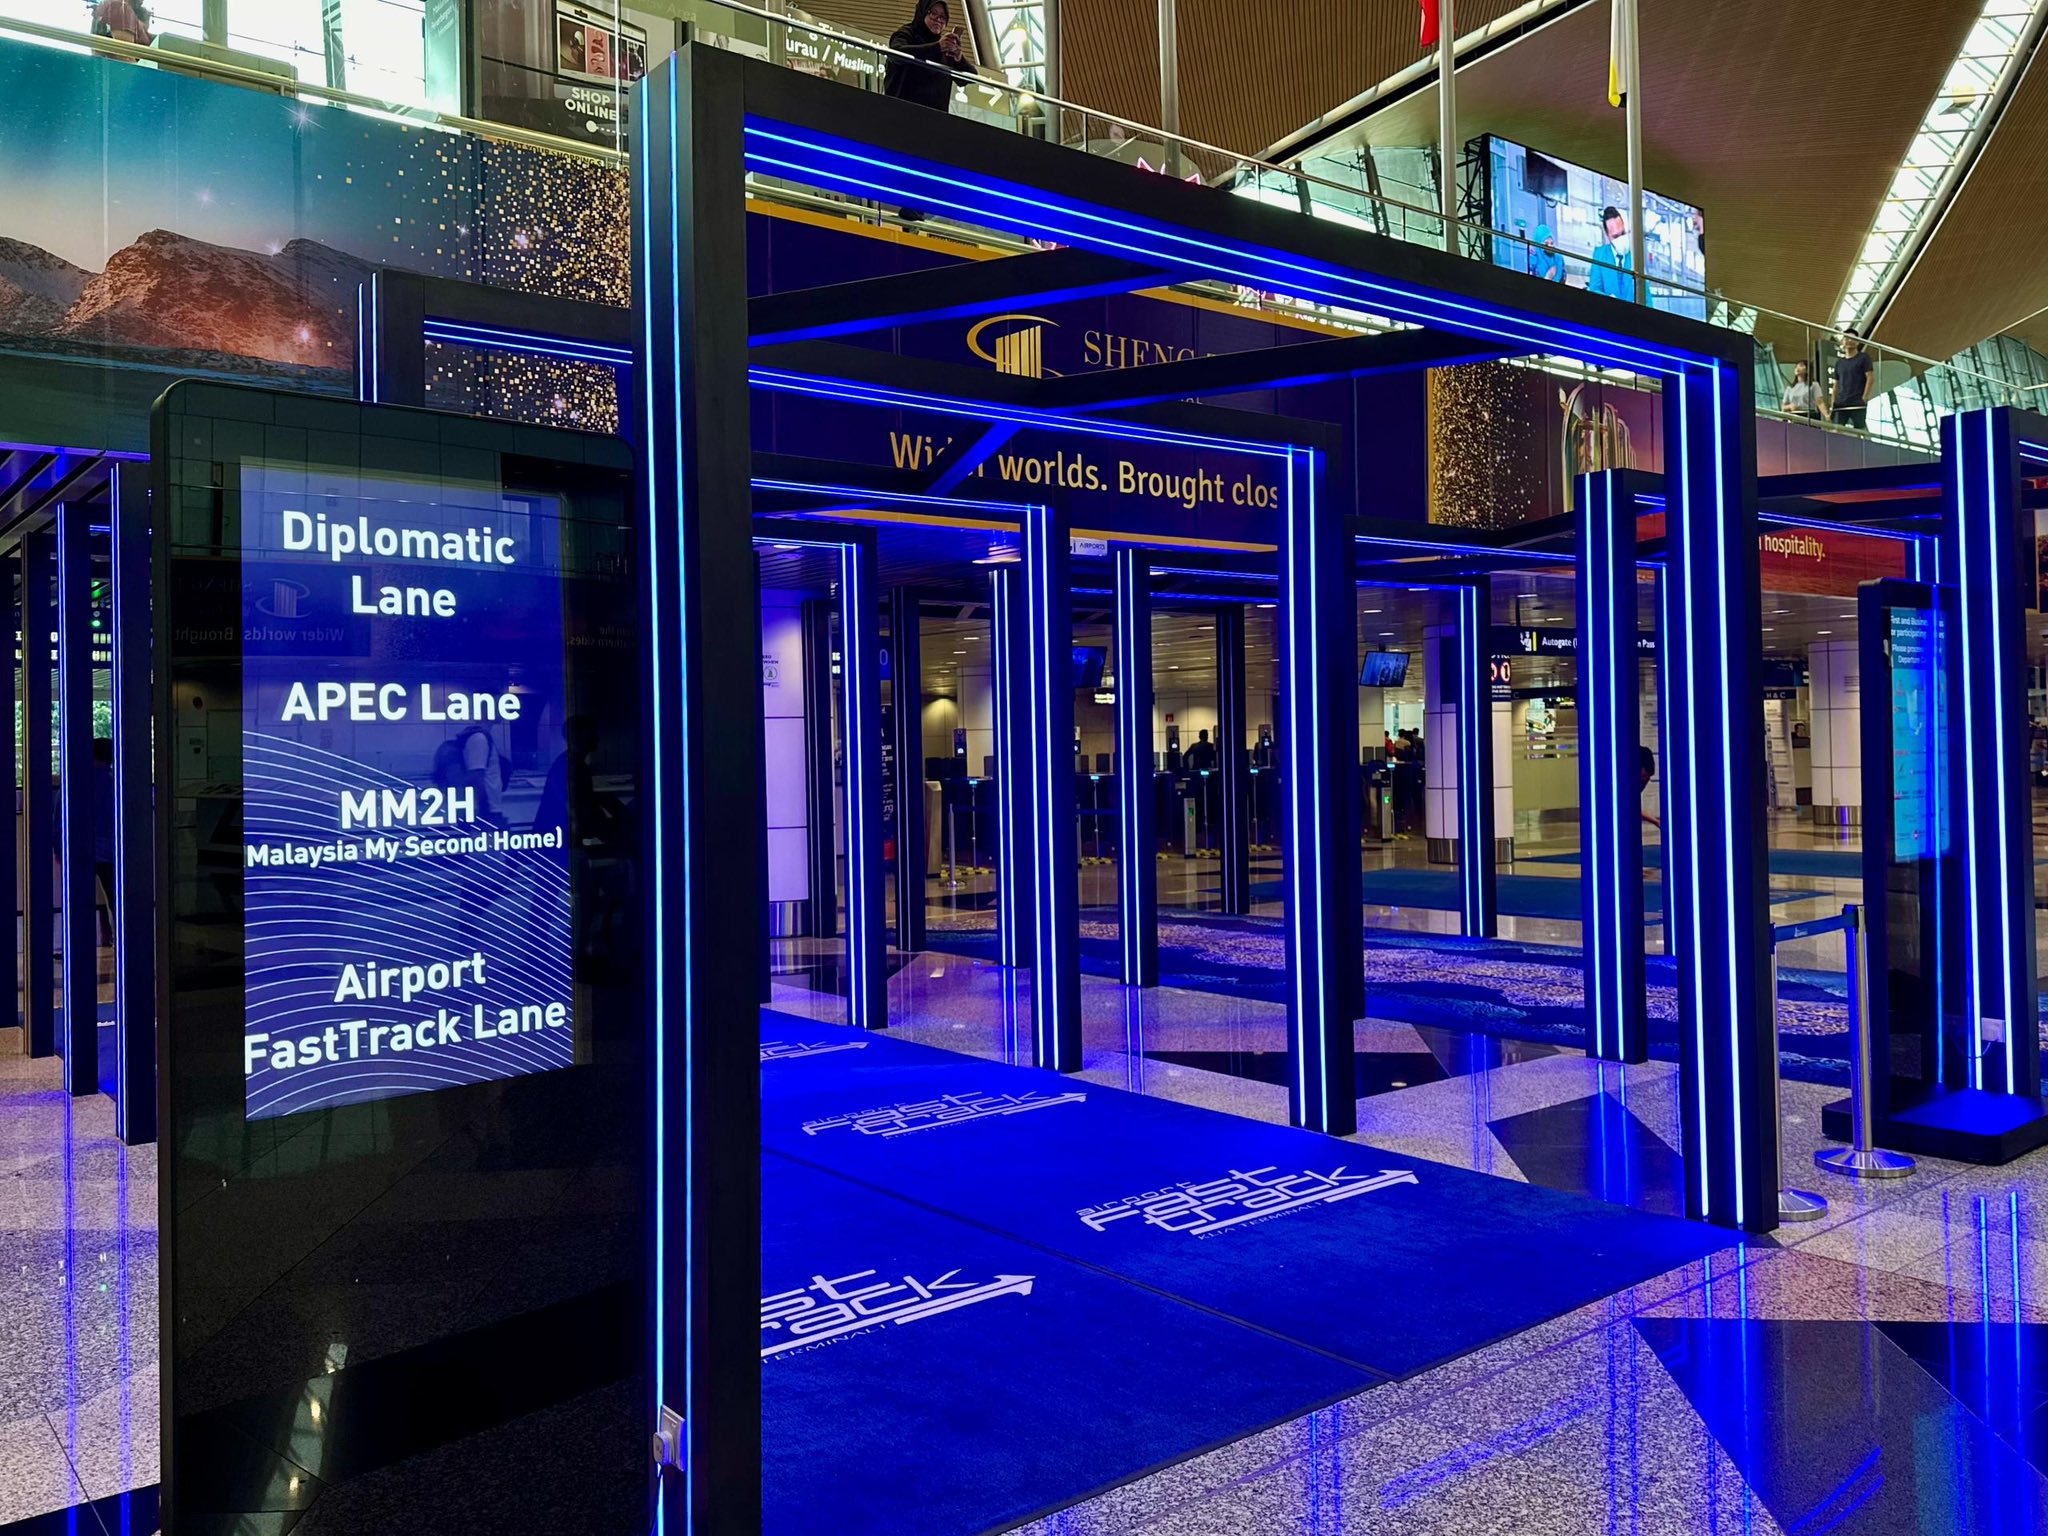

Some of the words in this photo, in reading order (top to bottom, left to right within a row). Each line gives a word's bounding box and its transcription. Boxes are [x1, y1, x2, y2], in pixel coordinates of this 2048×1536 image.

[786, 38, 818, 59] urau
[834, 51, 874, 74] Muslim
[565, 99, 617, 121] ONLINE
[572, 87, 610, 106] SHOP
[998, 450, 1107, 491] worlds.
[1118, 461, 1224, 509] Brought
[1231, 474, 1278, 509] clos
[283, 510, 515, 564] Diplomatic
[1764, 534, 1826, 562] hospitality.
[352, 575, 457, 617] Lane
[1541, 636, 1572, 649] Autogate
[281, 682, 407, 721] APEC
[421, 683, 521, 721] Lane
[341, 786, 475, 829] MM2H
[244, 840, 358, 868] Malaysia
[366, 837, 400, 863] My
[405, 832, 487, 857] Second
[493, 826, 563, 851] Home)
[333, 952, 486, 1003] Airport
[244, 1009, 462, 1075] FastTrack
[473, 1001, 567, 1041] Lane
[851, 1091, 1051, 1135] track
[1143, 1166, 1370, 1232] track
[761, 1269, 891, 1323] st
[761, 1268, 980, 1335] ack
